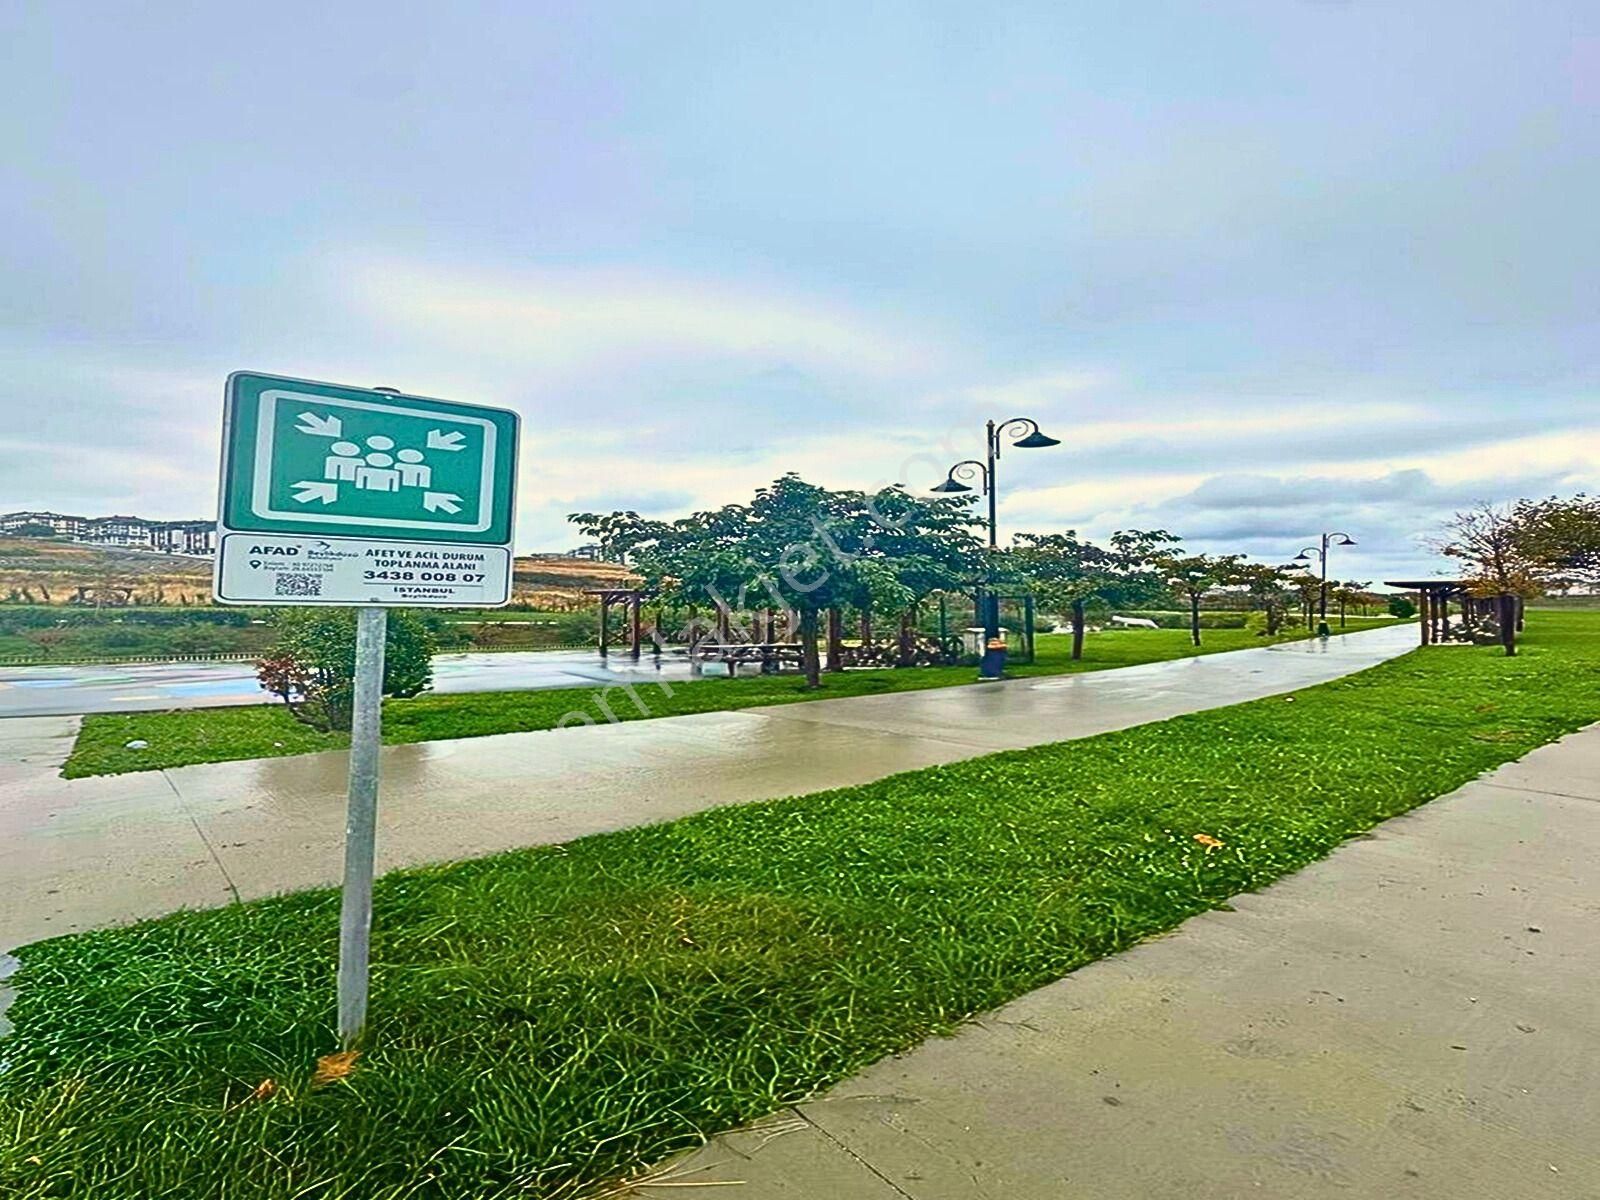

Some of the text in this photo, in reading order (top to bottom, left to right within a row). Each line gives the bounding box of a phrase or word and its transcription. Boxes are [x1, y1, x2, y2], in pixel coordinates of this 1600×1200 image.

[249, 545, 299, 556] AFAD
[365, 548, 395, 558] AFET
[397, 550, 412, 559] VE
[443, 552, 485, 562] DURUM
[374, 559, 476, 571] TOPLANMA ALANI
[363, 570, 486, 583] 3438 008 07
